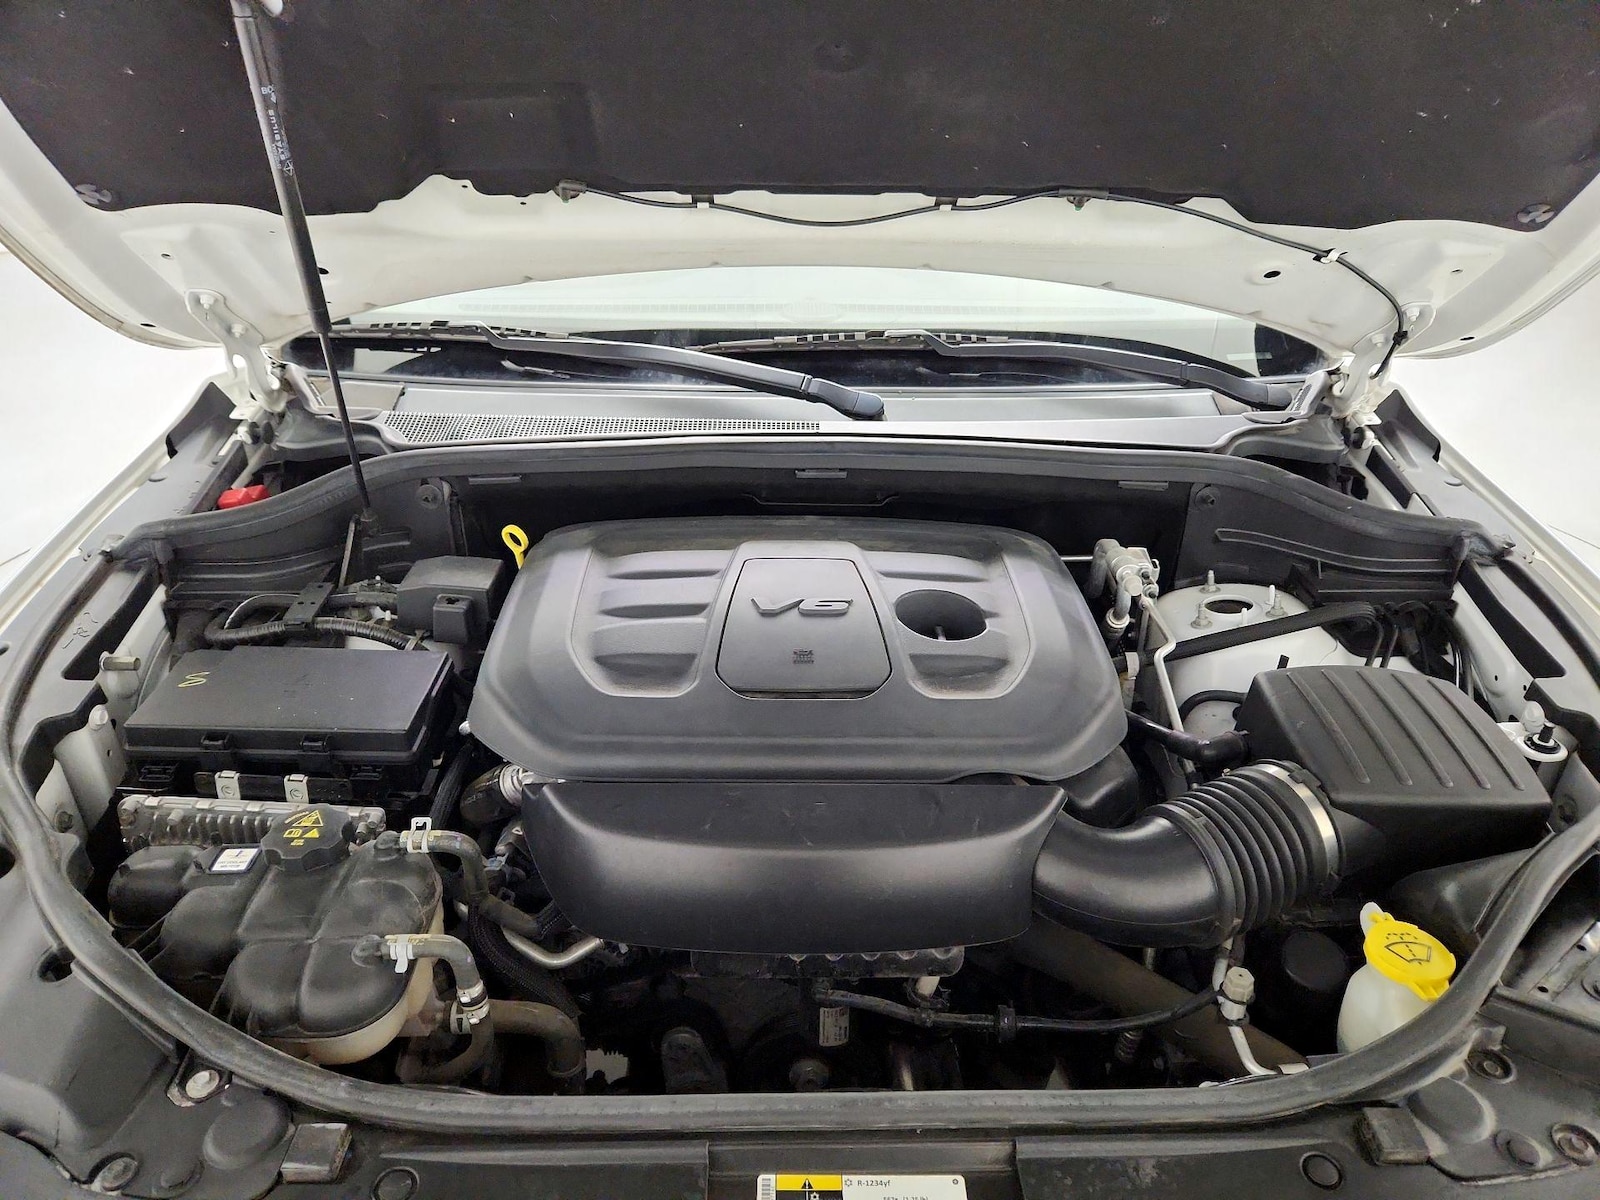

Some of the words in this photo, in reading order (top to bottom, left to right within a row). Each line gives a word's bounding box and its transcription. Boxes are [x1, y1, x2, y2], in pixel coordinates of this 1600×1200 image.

[267, 109, 286, 161] STABILUS
[750, 597, 854, 617] V6
[857, 1179, 891, 1189] R-1234yf
